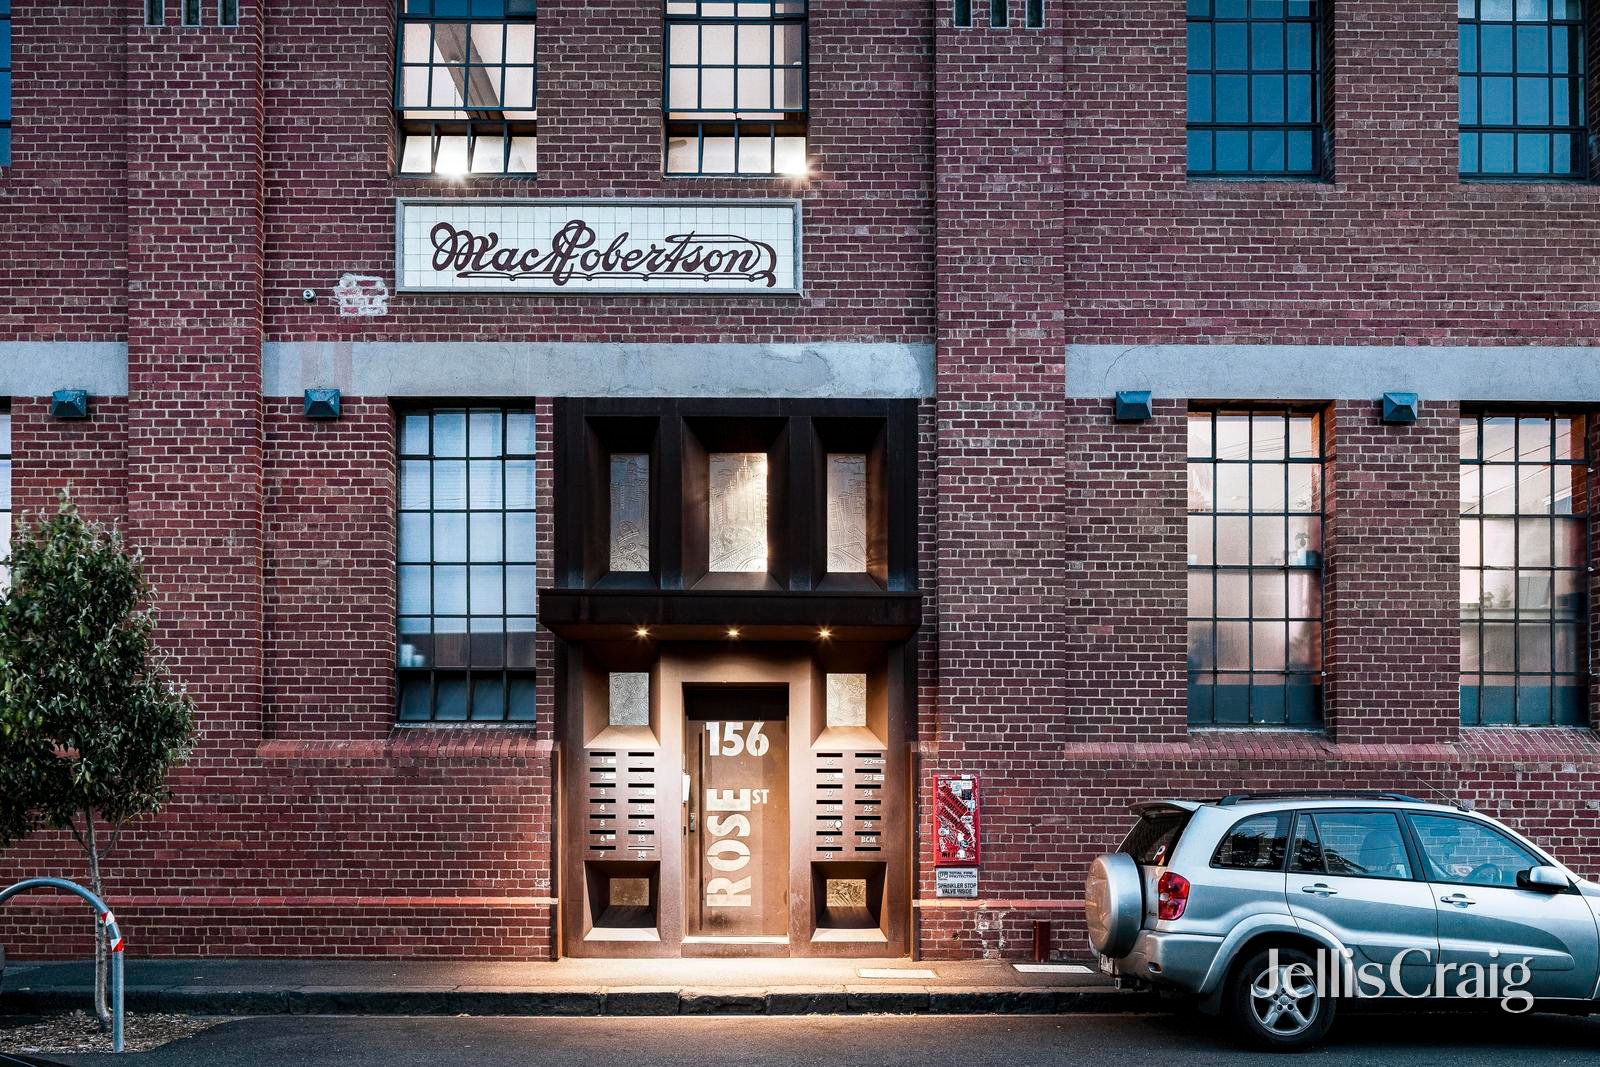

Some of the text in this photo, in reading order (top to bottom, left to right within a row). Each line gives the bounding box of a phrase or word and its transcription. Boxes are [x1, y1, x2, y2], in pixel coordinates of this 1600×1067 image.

[430, 219, 777, 288] MacRobertson
[706, 721, 769, 757] 156
[706, 789, 769, 906] ROSE ST
